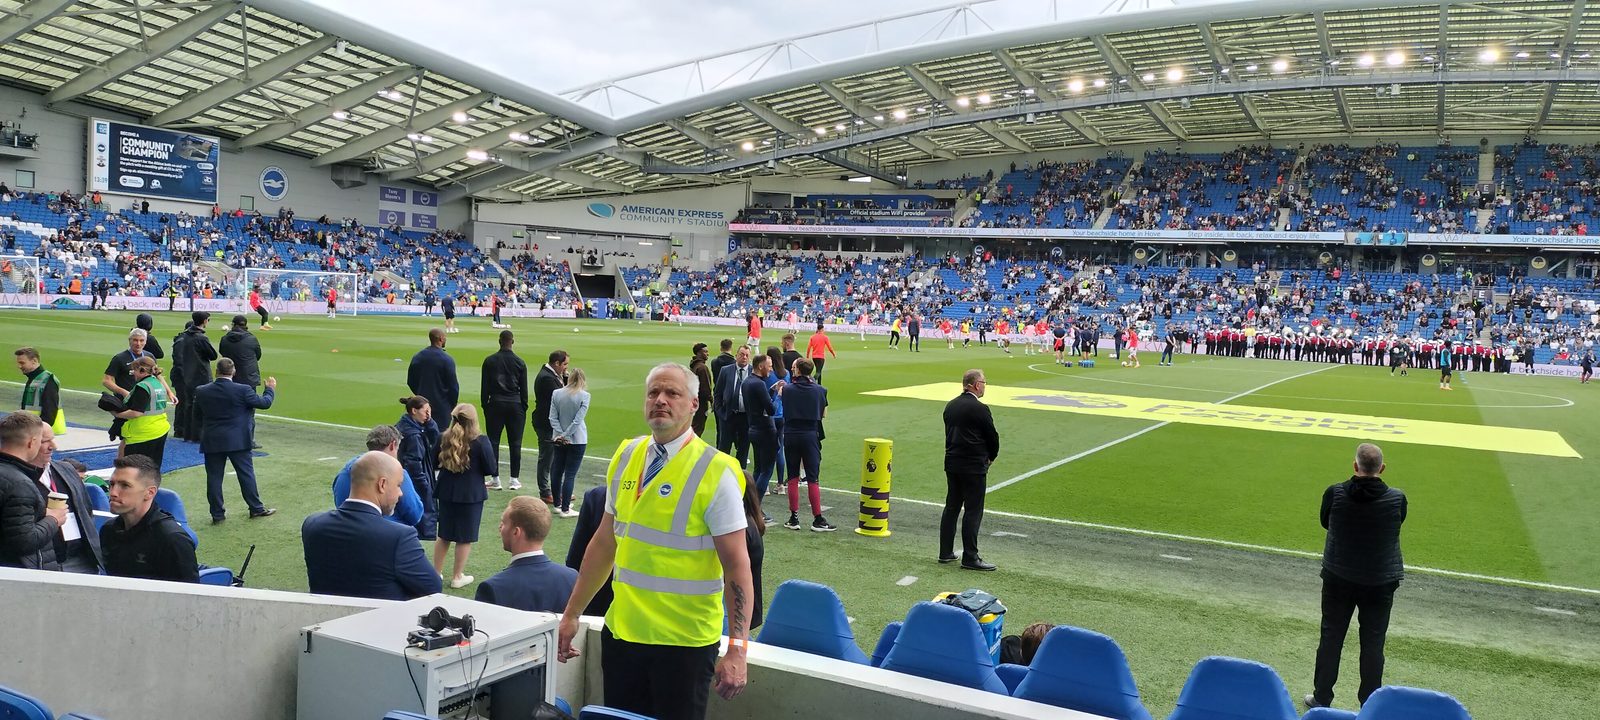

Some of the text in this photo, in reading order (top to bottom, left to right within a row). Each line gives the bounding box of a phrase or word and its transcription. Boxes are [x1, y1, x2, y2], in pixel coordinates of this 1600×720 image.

[122, 137, 174, 152] COMMUNITY
[122, 146, 168, 160] CHAMPION
[620, 213, 683, 224] COMMUNITY
[621, 205, 723, 219] AMERICAN EXPRESS
